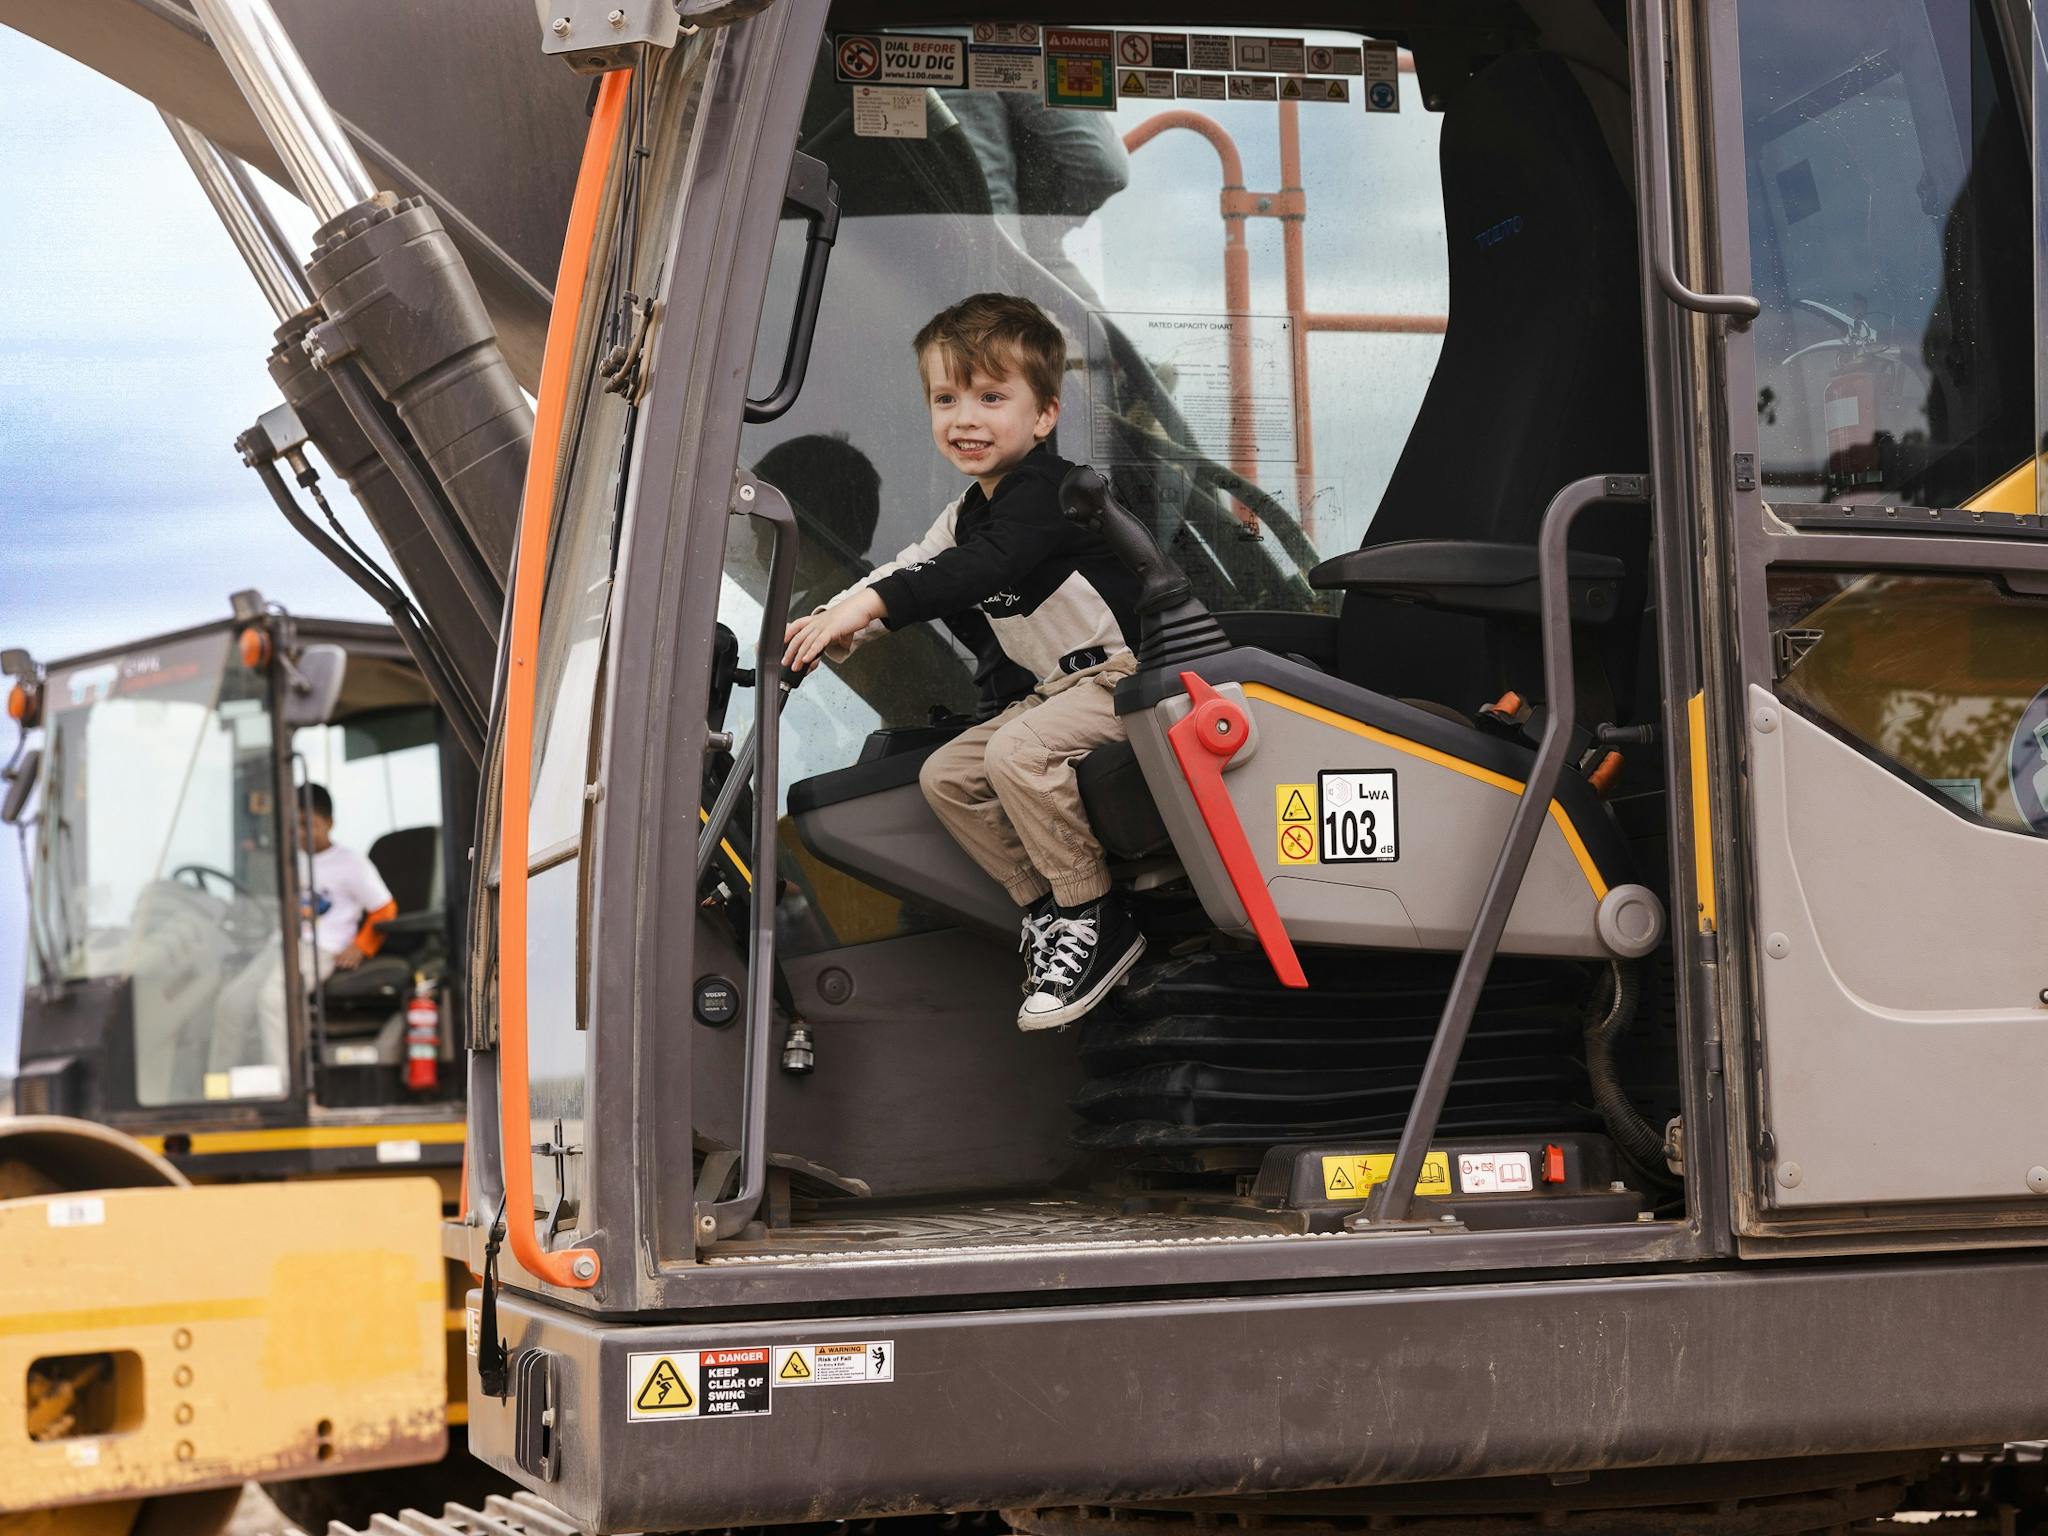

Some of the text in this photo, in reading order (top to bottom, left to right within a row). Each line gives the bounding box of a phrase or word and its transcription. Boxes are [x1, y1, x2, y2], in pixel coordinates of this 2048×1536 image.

[885, 41, 956, 54] DIAL BEFORE
[1062, 36, 1110, 48] DANGER
[885, 53, 956, 71] YOU DIG
[885, 71, 954, 81] www.1100.com.au
[1148, 321, 1233, 331] RATED CAPACITY CHART
[1326, 810, 1394, 855] 103 dB
[828, 1346, 861, 1354] WARNING
[719, 1351, 764, 1364] DANGER
[708, 1367, 740, 1379] KEEP
[708, 1377, 764, 1390] CLEAR OF
[708, 1389, 746, 1402] SWING
[708, 1401, 740, 1413] AREA
